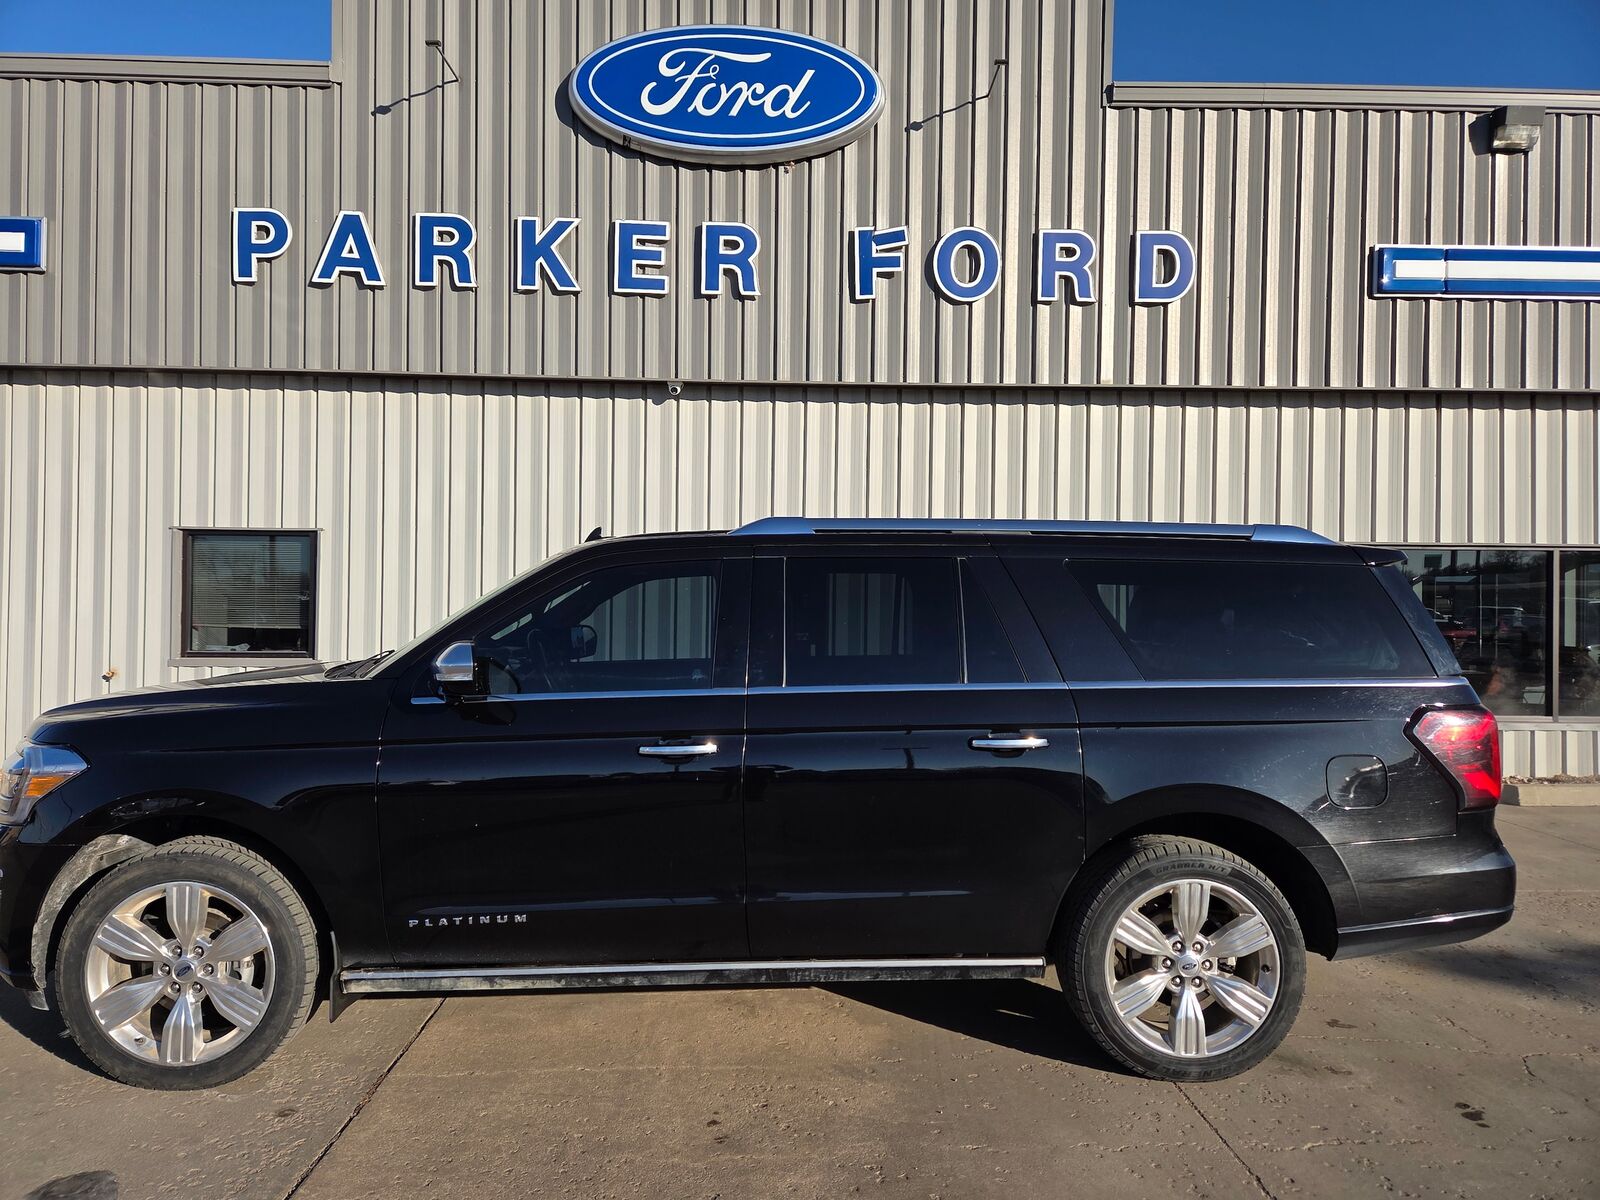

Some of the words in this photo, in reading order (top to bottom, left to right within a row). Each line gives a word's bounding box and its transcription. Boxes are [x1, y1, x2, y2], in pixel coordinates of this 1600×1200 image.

[640, 47, 816, 119] Ford
[232, 207, 761, 297] PARKER
[854, 225, 1197, 303] FORD
[408, 914, 527, 928] PLATINUM
